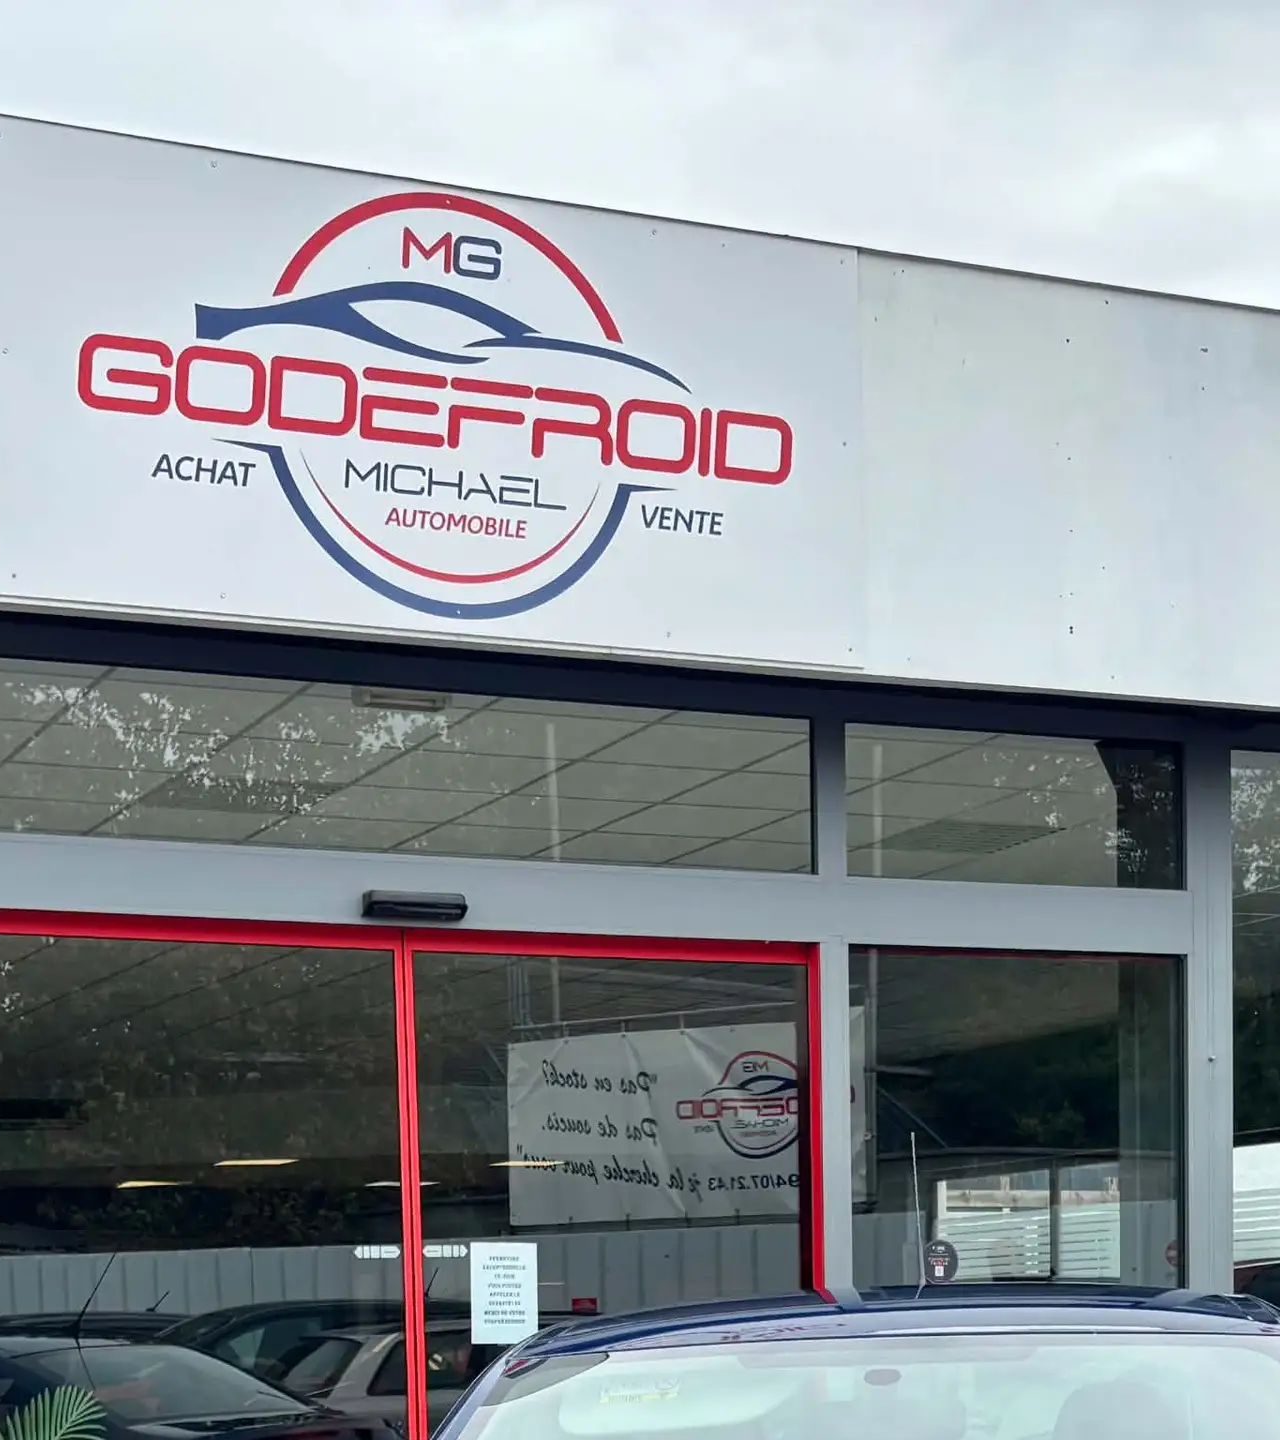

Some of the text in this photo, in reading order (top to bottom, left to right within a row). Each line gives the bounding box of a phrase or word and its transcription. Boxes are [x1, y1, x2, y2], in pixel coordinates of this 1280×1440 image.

[402, 226, 503, 282] MG
[77, 333, 794, 486] GODEFROID
[151, 453, 257, 489] ACHAT
[344, 458, 567, 511] MICHAEL
[384, 506, 528, 540] AUTOMOBILE
[641, 504, 723, 537] VENTE
